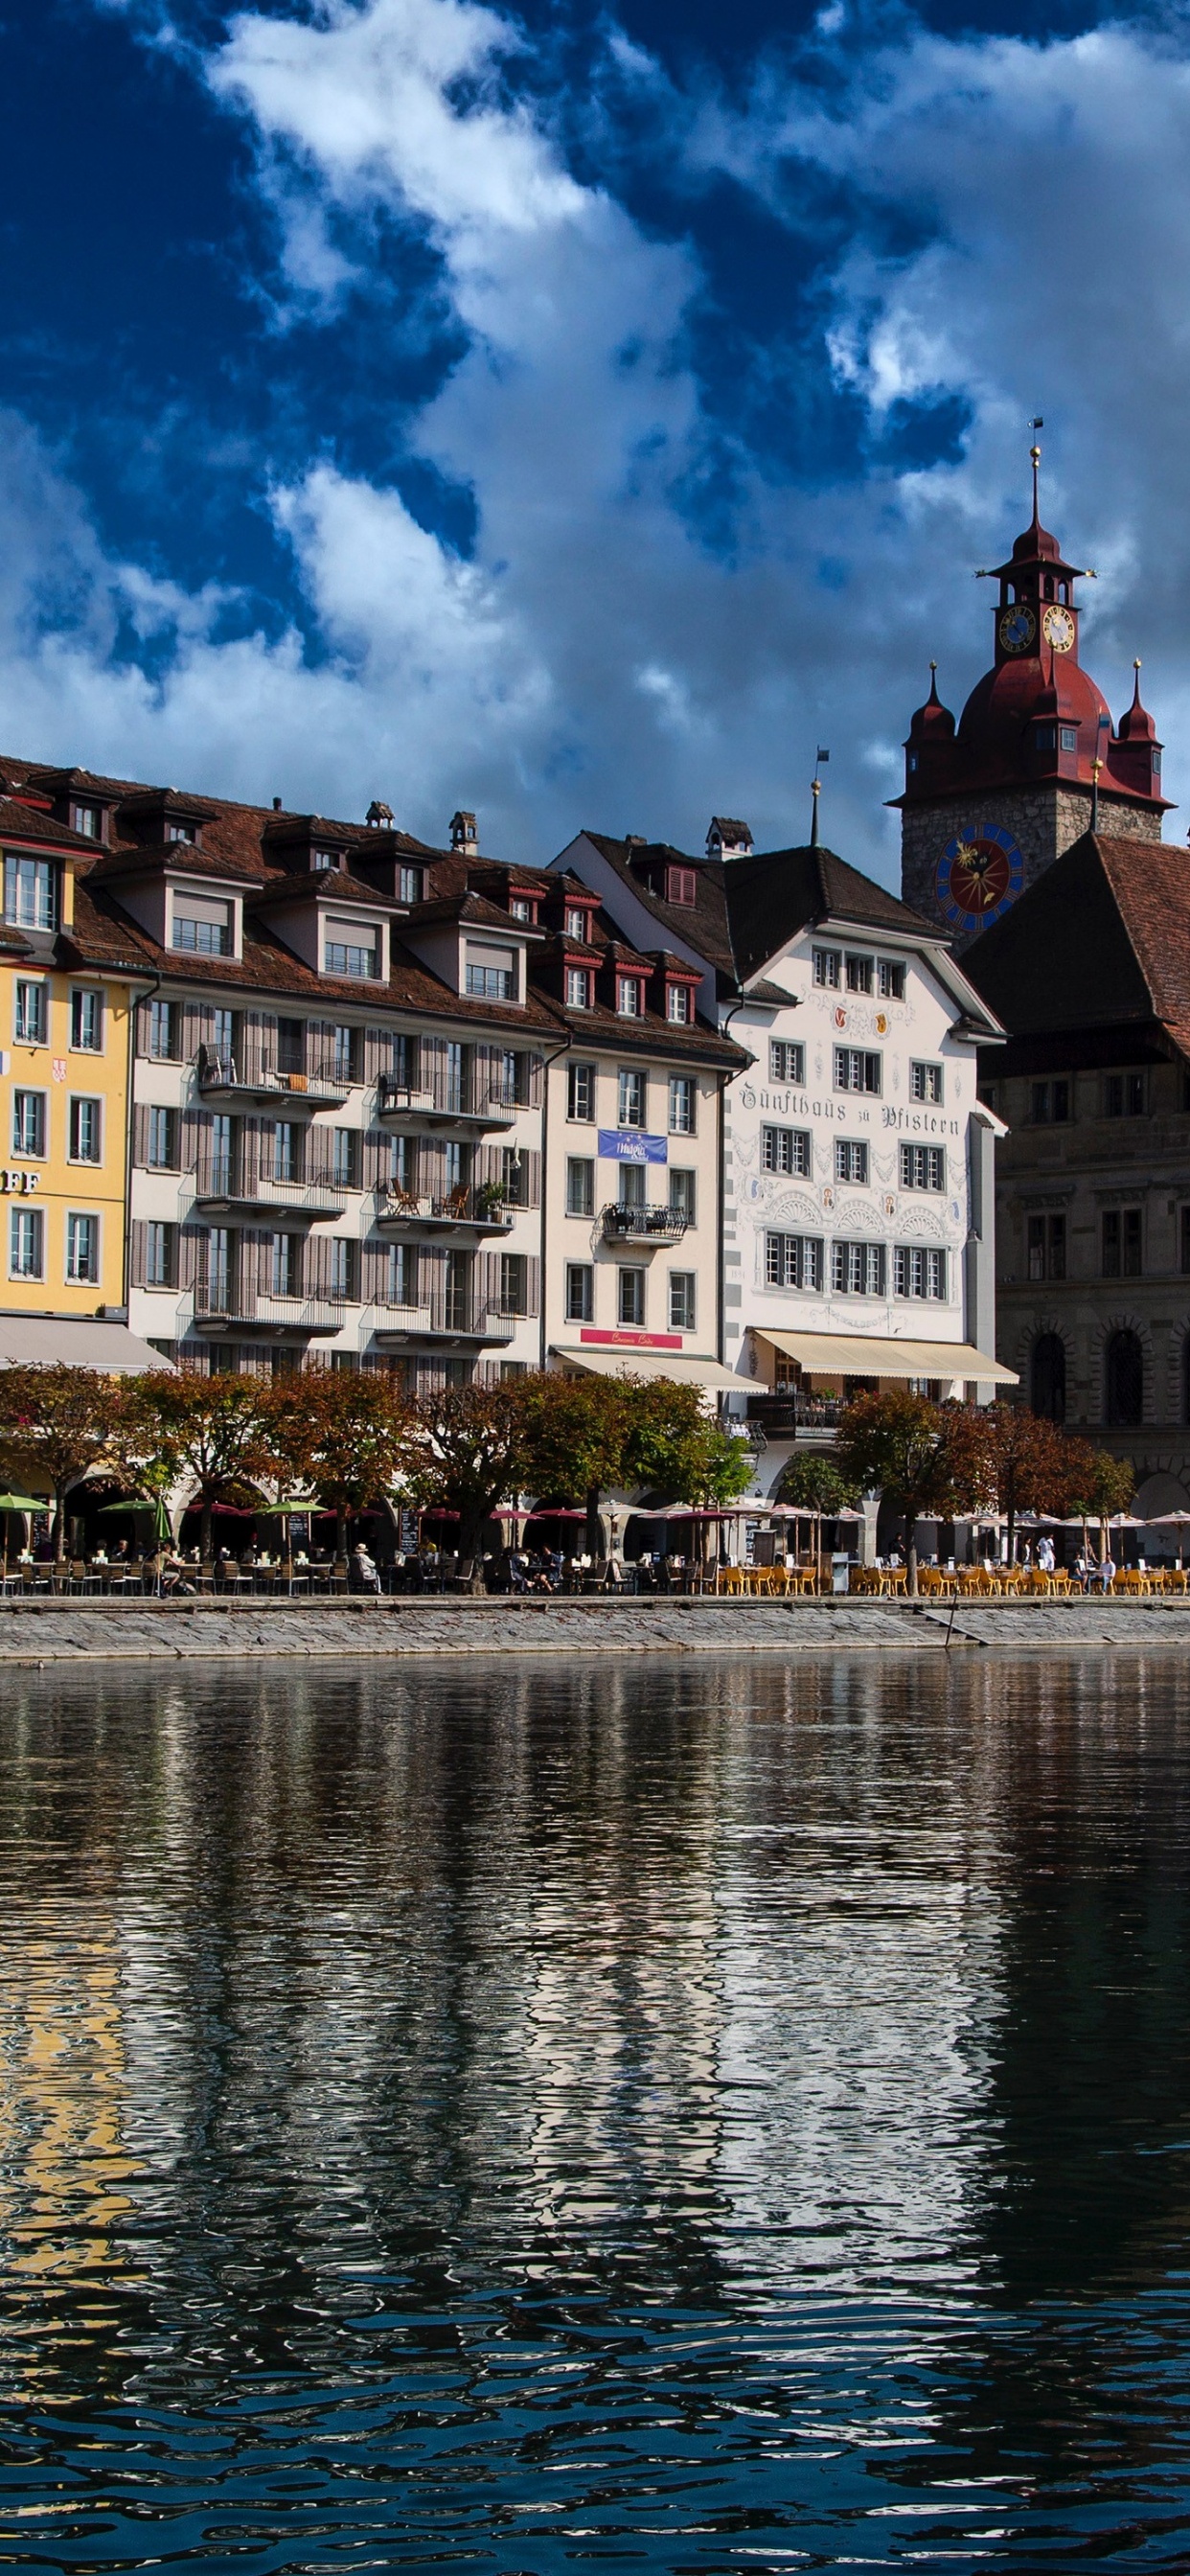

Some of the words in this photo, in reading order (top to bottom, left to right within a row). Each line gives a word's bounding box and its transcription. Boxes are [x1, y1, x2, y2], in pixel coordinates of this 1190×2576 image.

[739, 1081, 846, 1121] Zunfthaus
[881, 1105, 959, 1136] Pfistern
[0, 1169, 41, 1193] FF
